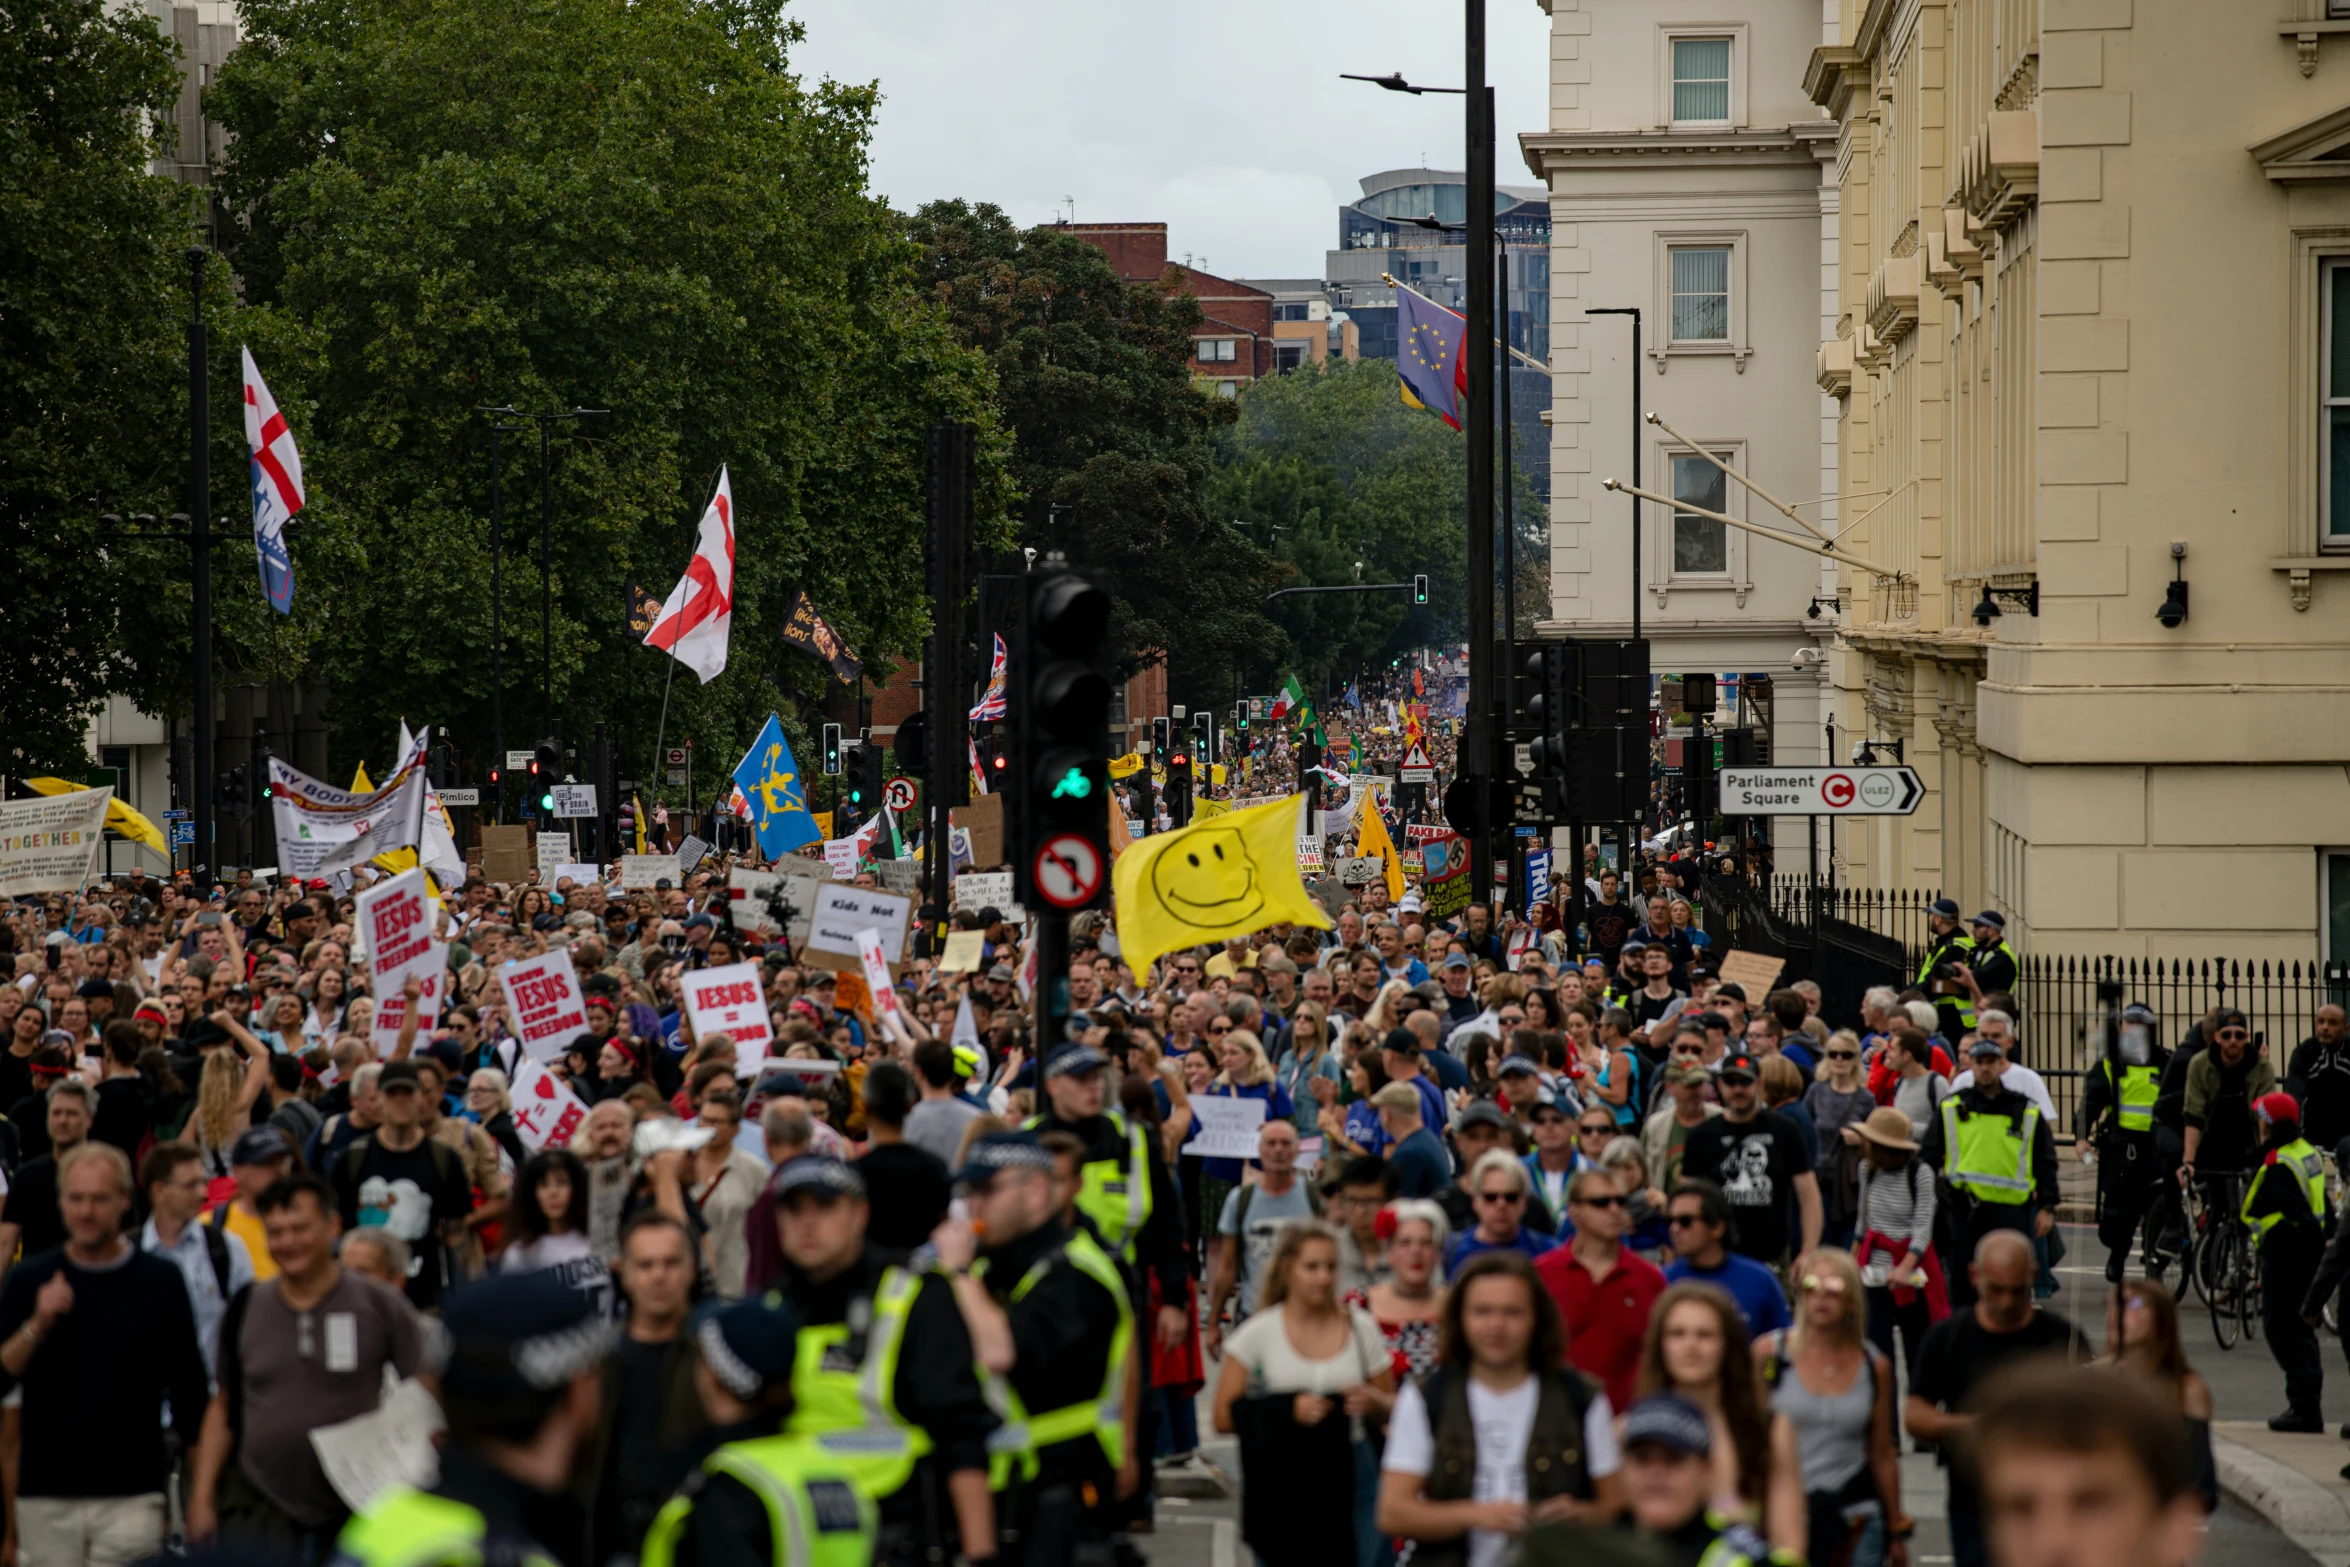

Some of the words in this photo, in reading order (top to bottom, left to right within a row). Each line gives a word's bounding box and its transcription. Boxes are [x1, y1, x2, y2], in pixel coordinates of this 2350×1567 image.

[784, 622, 810, 642] lions
[276, 766, 301, 785] MY
[303, 783, 357, 806] BODY,
[1727, 774, 1815, 788] Parliament
[1865, 787, 1890, 795] ULEZ
[440, 792, 475, 801] Pimlico
[569, 800, 589, 808] BRAIN
[1742, 791, 1800, 807] Square
[1408, 825, 1434, 837] FAKE
[4, 830, 81, 852] TOGETHER
[892, 862, 924, 873] FREEDO
[1297, 853, 1323, 864] CINE
[11, 866, 18, 874] by
[958, 876, 990, 888] IMAGINE
[1000, 875, 1006, 883] A
[1434, 883, 1447, 894] AM
[957, 890, 969, 898] SO
[830, 899, 859, 912] Kids
[870, 905, 895, 917] Not
[374, 896, 424, 943] JESUS
[820, 928, 853, 943] Guinea
[375, 935, 431, 977] FREEDOM
[508, 965, 546, 987] KNOW
[513, 972, 570, 1013] JESUS
[695, 980, 757, 1011] JESUS
[521, 1005, 559, 1025] KNOW
[521, 1010, 585, 1043] FREEDOM
[544, 1101, 585, 1149] ESUS
